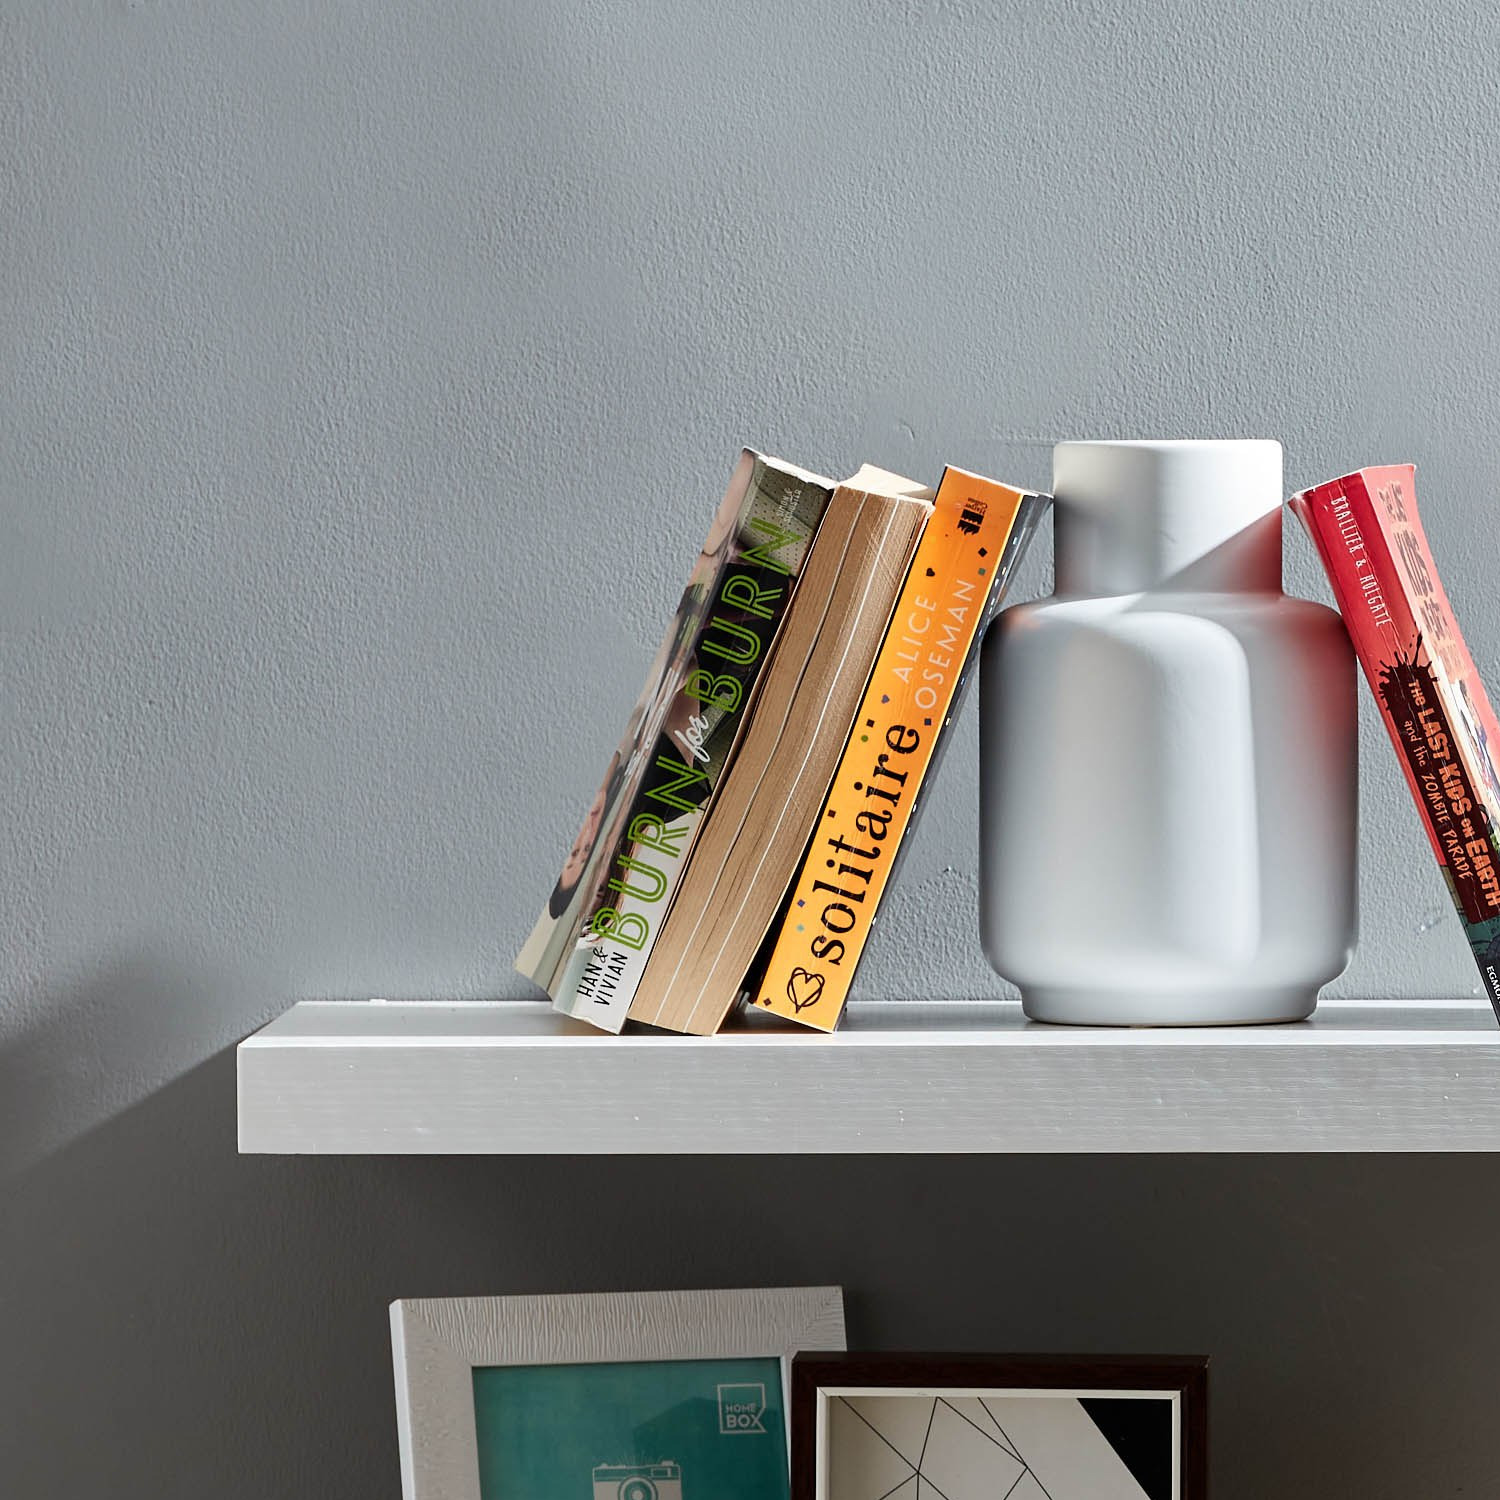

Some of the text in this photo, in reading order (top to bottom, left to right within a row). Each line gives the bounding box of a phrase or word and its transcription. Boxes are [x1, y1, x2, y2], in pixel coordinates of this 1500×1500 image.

[1355, 558, 1367, 568] &
[1360, 574, 1392, 628] HOLGATE
[891, 597, 936, 684] ALICE
[915, 580, 978, 711] OSEMAN
[591, 516, 803, 951] BURN for BURN
[1404, 720, 1474, 880] and the ZOMBIE PARADE
[1418, 707, 1450, 760] LAST
[1438, 762, 1472, 817] KIDS
[1461, 817, 1475, 838] ON
[810, 724, 922, 967] solitaire
[576, 946, 608, 998] HAN &
[593, 951, 628, 1006] VIVIAN
[726, 1403, 756, 1413] HOME
[727, 1413, 764, 1429] BOX
